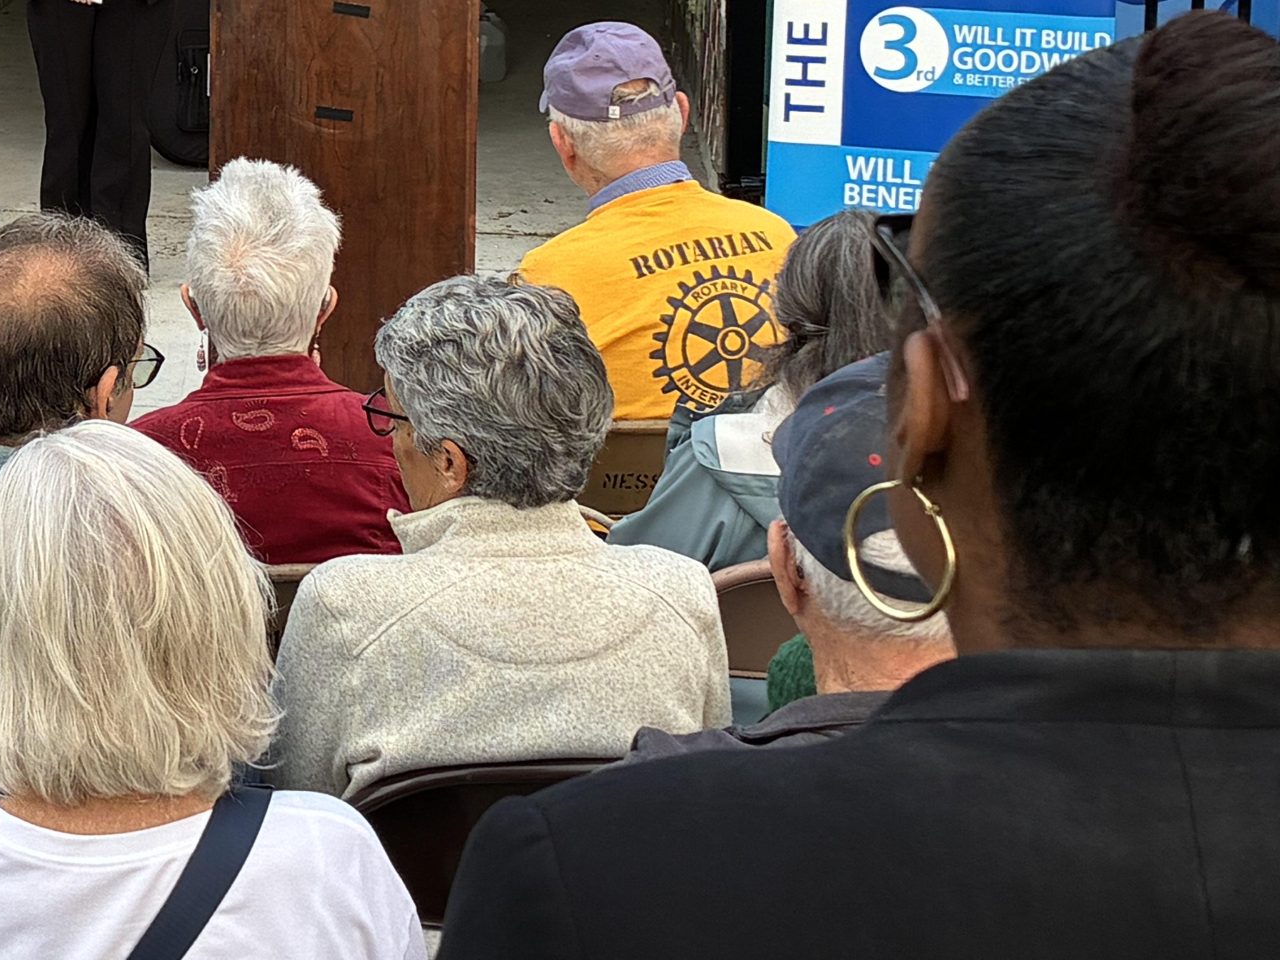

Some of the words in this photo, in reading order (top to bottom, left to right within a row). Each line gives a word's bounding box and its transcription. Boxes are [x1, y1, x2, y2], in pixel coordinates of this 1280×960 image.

[873, 14, 936, 82] 3rd
[953, 24, 1010, 46] WILL
[1015, 28, 1037, 48] IT
[1041, 30, 1112, 51] BUILD
[783, 21, 828, 122] THE
[952, 46, 1076, 74] GOODW
[953, 73, 964, 86] &
[966, 74, 1014, 89] BETTER
[845, 155, 921, 185] WILL
[629, 230, 773, 280] ROTARIAN
[692, 282, 748, 304] ROTARY
